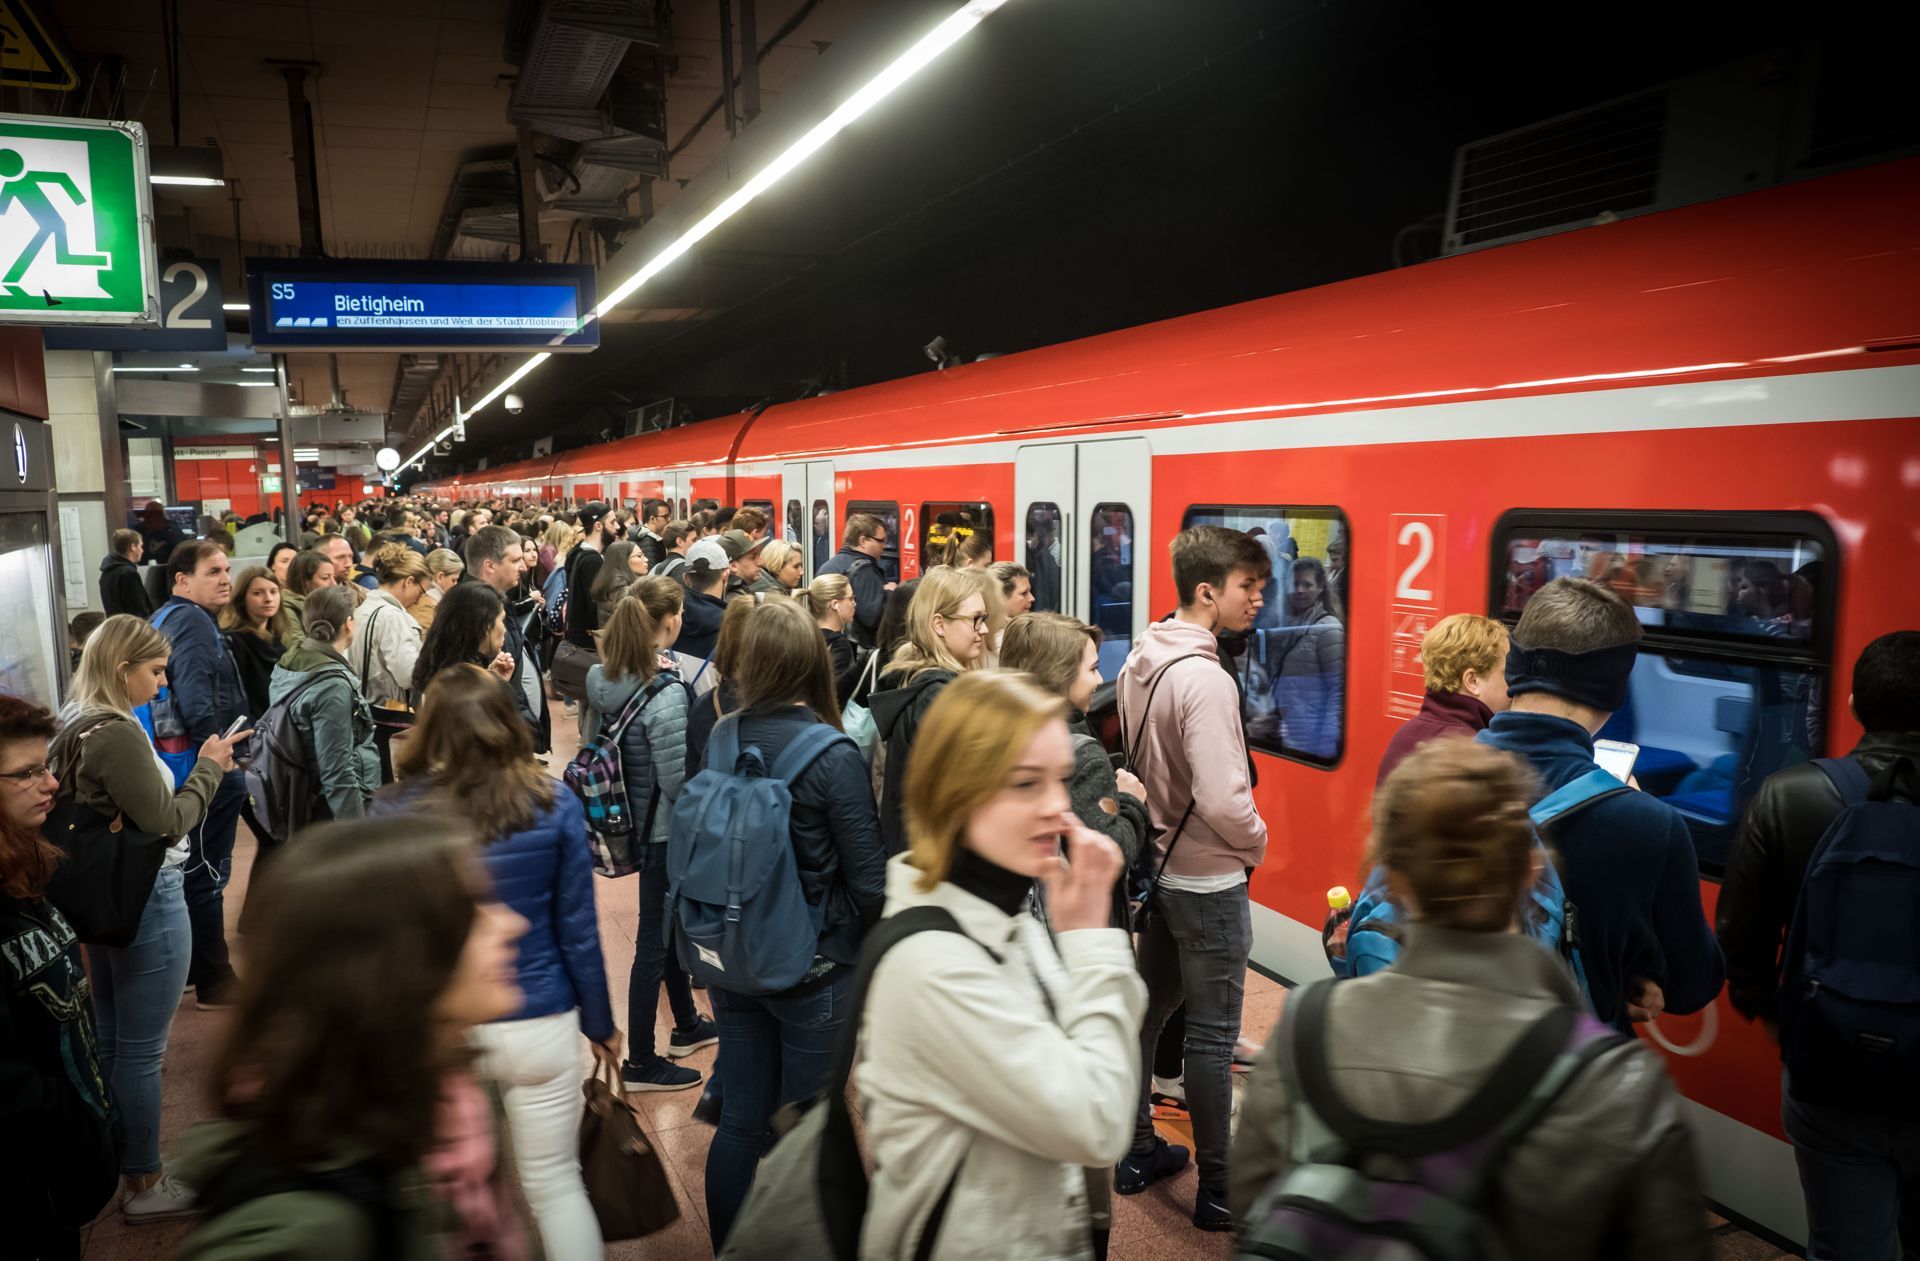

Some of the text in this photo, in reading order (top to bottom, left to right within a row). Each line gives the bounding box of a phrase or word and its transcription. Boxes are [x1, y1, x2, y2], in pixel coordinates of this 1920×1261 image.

[162, 262, 212, 329] 2
[271, 283, 295, 300] S5
[334, 295, 425, 315] Bietigheim
[353, 316, 428, 326] Zuffenhausen
[430, 316, 449, 326] und
[451, 316, 474, 326] Weil
[476, 316, 493, 326] der
[904, 508, 915, 550] 2
[1395, 521, 1435, 601] 2
